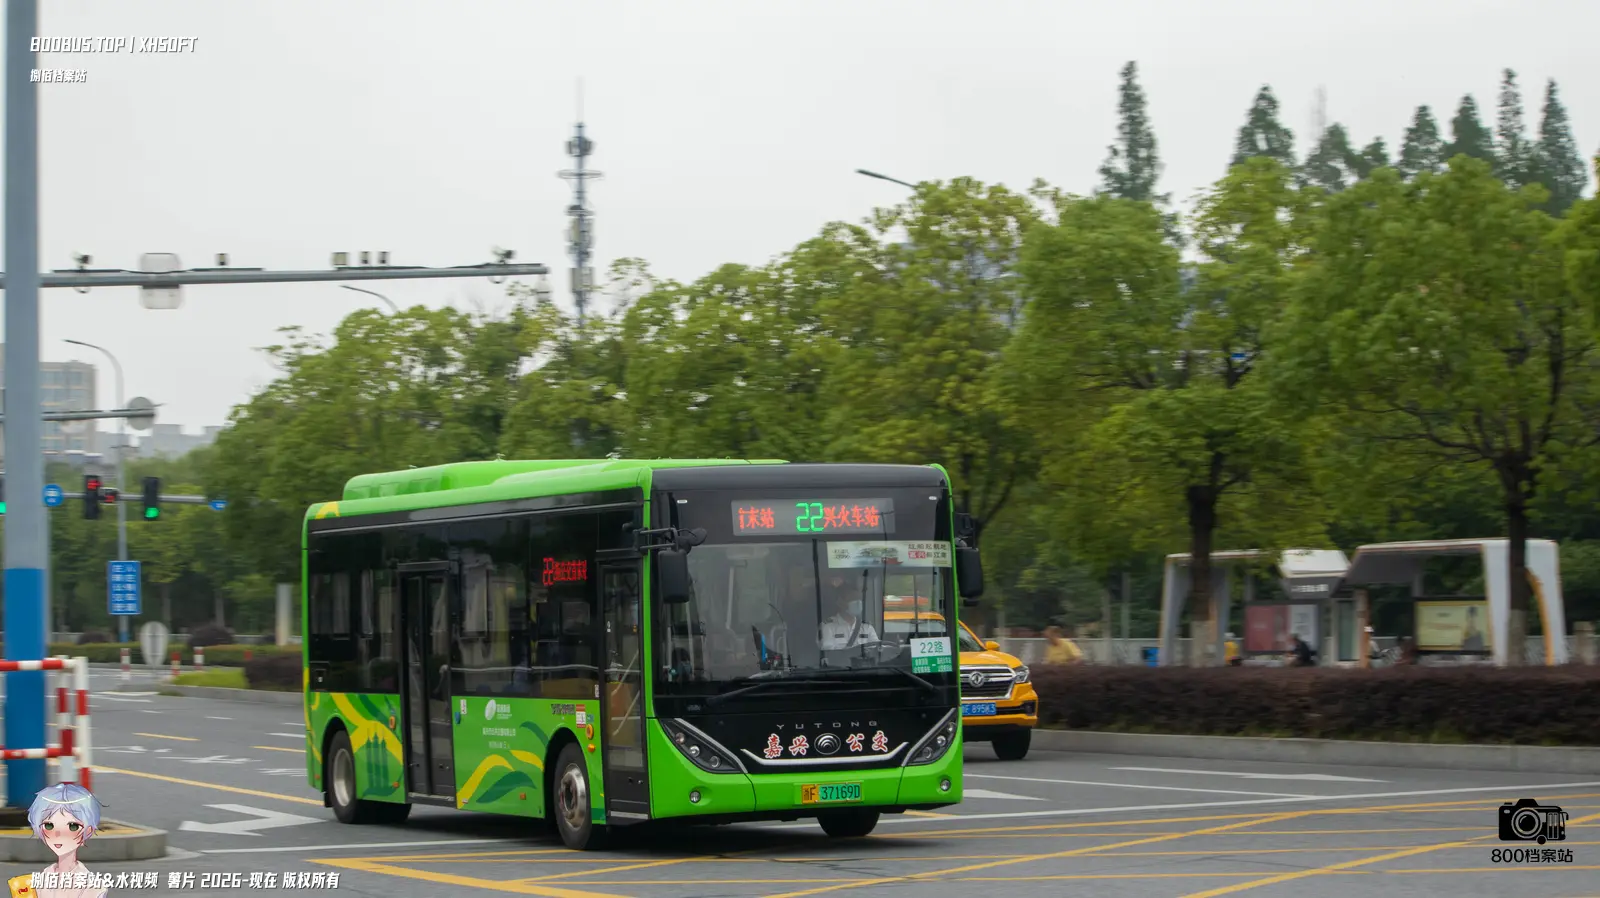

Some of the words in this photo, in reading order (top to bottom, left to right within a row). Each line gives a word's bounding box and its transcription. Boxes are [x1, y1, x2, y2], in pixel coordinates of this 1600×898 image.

[796, 502, 824, 532] 22
[920, 641, 943, 654] 22路
[777, 720, 878, 730] YUTONG
[764, 733, 810, 759] 嘉兴
[846, 730, 888, 752] 公交
